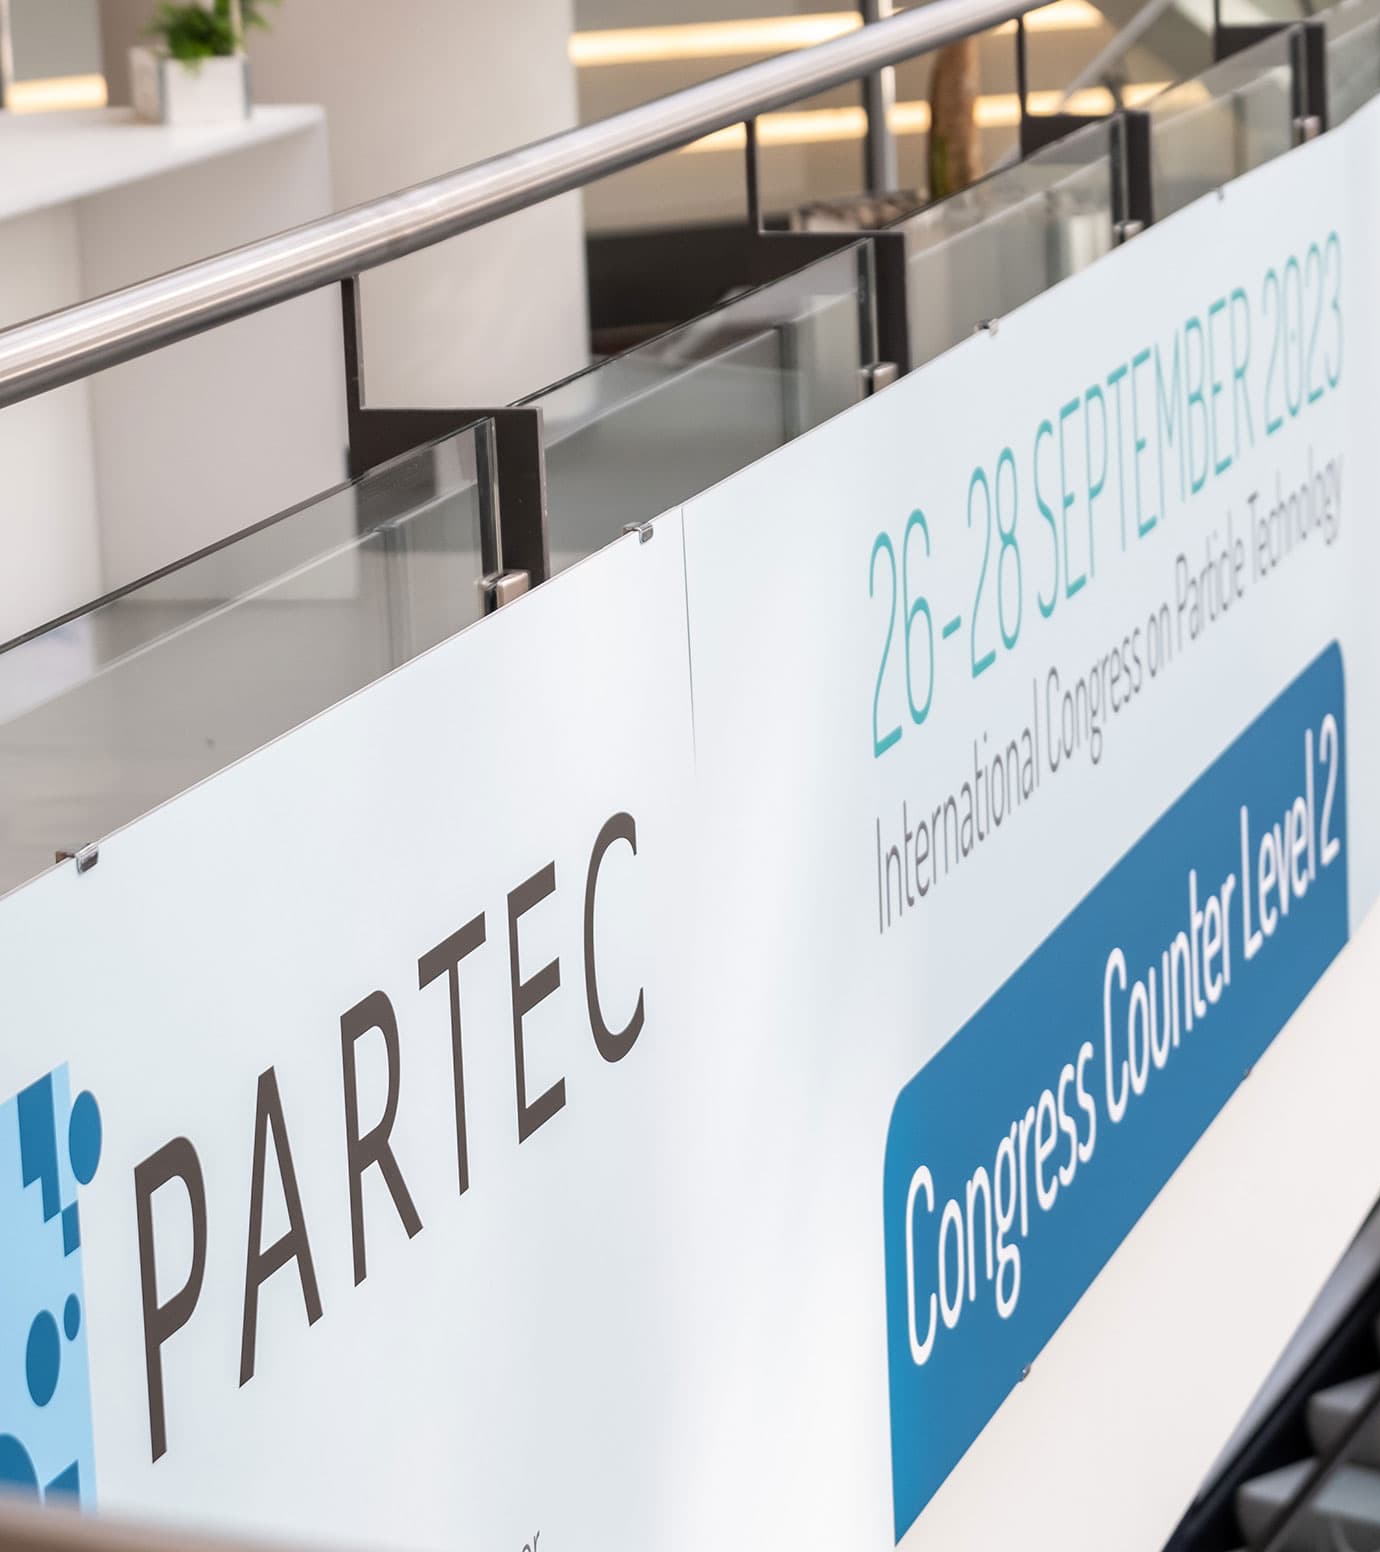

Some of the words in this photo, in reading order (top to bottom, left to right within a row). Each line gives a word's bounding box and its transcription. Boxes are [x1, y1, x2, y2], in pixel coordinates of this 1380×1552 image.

[877, 678, 1040, 934] International
[1046, 626, 1143, 773] Congress
[1148, 601, 1173, 678] on
[1176, 509, 1245, 650] Particle
[1248, 446, 1344, 580] Technology
[1033, 286, 1254, 619] SEPTEMBER
[1263, 231, 1343, 435] 2023
[134, 812, 645, 1464] PARTEC
[906, 1041, 1094, 1365] Congress
[1103, 869, 1235, 1123] Counter
[1240, 728, 1315, 960] Level
[1318, 714, 1341, 866] 2
